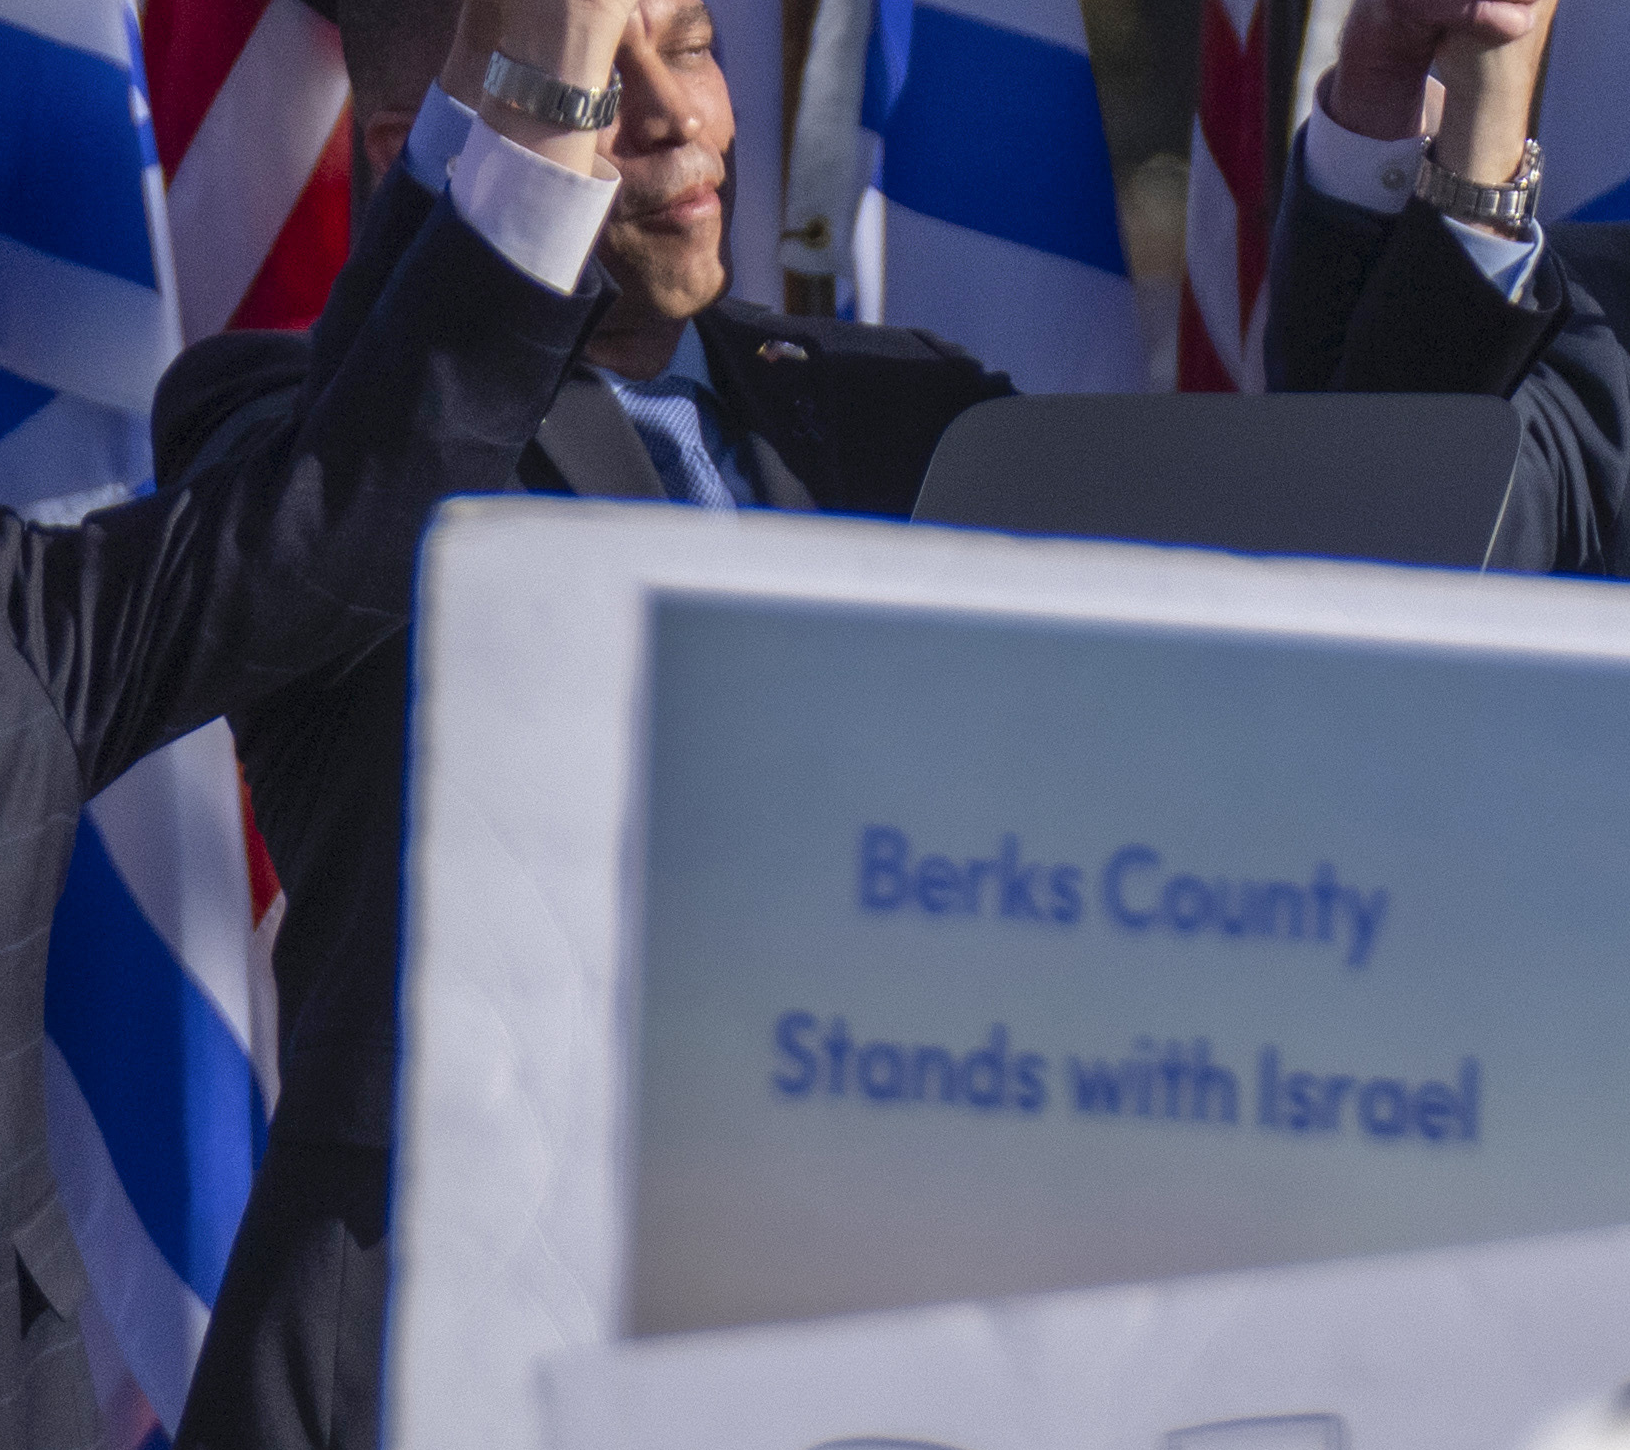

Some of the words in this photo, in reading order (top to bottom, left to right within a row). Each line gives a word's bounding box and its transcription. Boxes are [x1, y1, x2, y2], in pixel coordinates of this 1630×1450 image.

[858, 824, 1082, 928] Berks
[1100, 842, 1388, 968] County
[772, 1009, 1047, 1113] Stands
[1066, 1035, 1240, 1125] with
[1256, 1044, 1483, 1144] Israel
